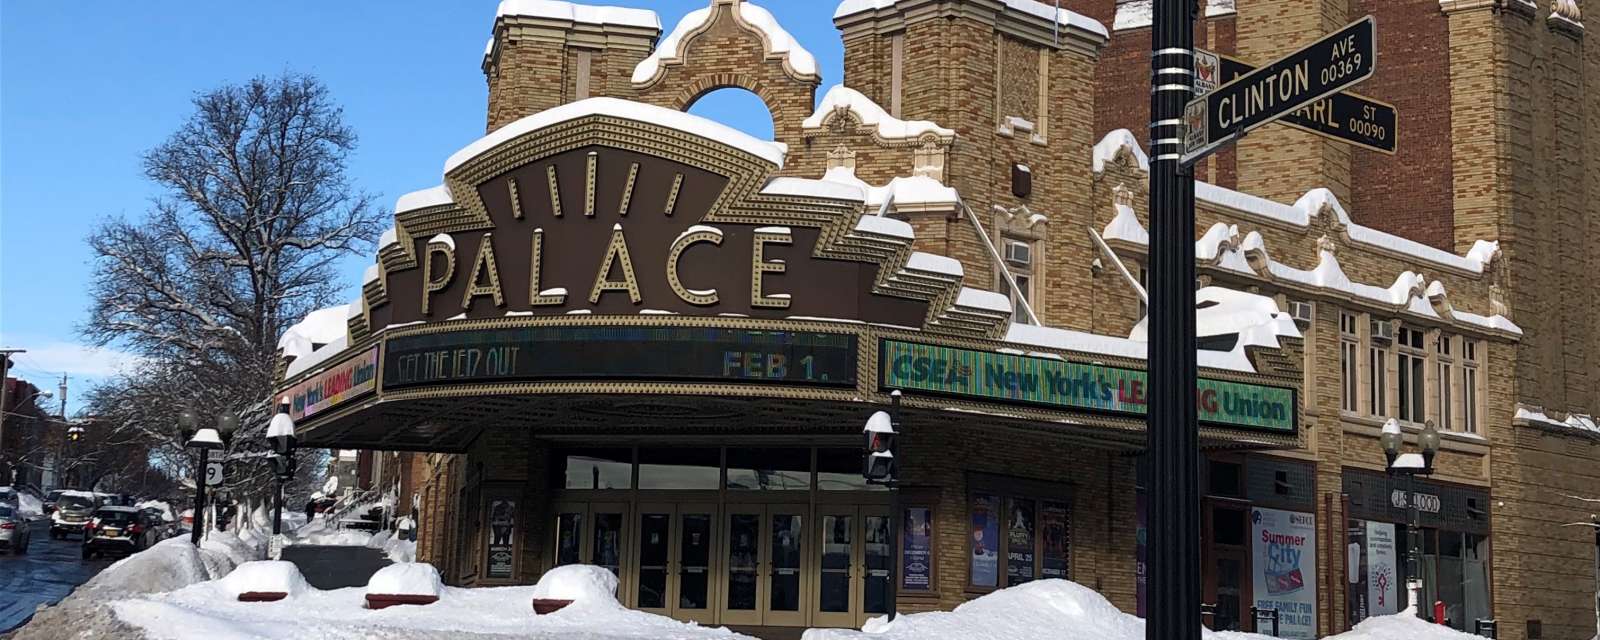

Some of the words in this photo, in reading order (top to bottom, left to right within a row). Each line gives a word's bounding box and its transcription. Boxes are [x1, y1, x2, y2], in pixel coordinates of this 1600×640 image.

[1331, 34, 1355, 61] AVE
[1321, 53, 1362, 86] 00369
[1218, 59, 1309, 129] CLINTON
[1291, 98, 1339, 129] ARL
[1363, 105, 1376, 121] ST
[1349, 117, 1385, 141] 00090
[421, 224, 793, 314] PALACE
[424, 350, 449, 379] THE
[486, 346, 520, 376] OUT
[722, 351, 787, 378] FEB
[324, 366, 353, 399] LEADING
[985, 363, 1038, 393] New
[1044, 368, 1112, 402] York's
[1224, 391, 1285, 421] Union
[207, 467, 216, 481] 9
[1262, 529, 1305, 546] Summer
[1008, 552, 1024, 561] APRIL
[1268, 544, 1301, 568] City
[1274, 601, 1297, 613] FAMILY
[1299, 602, 1312, 614] FUN
